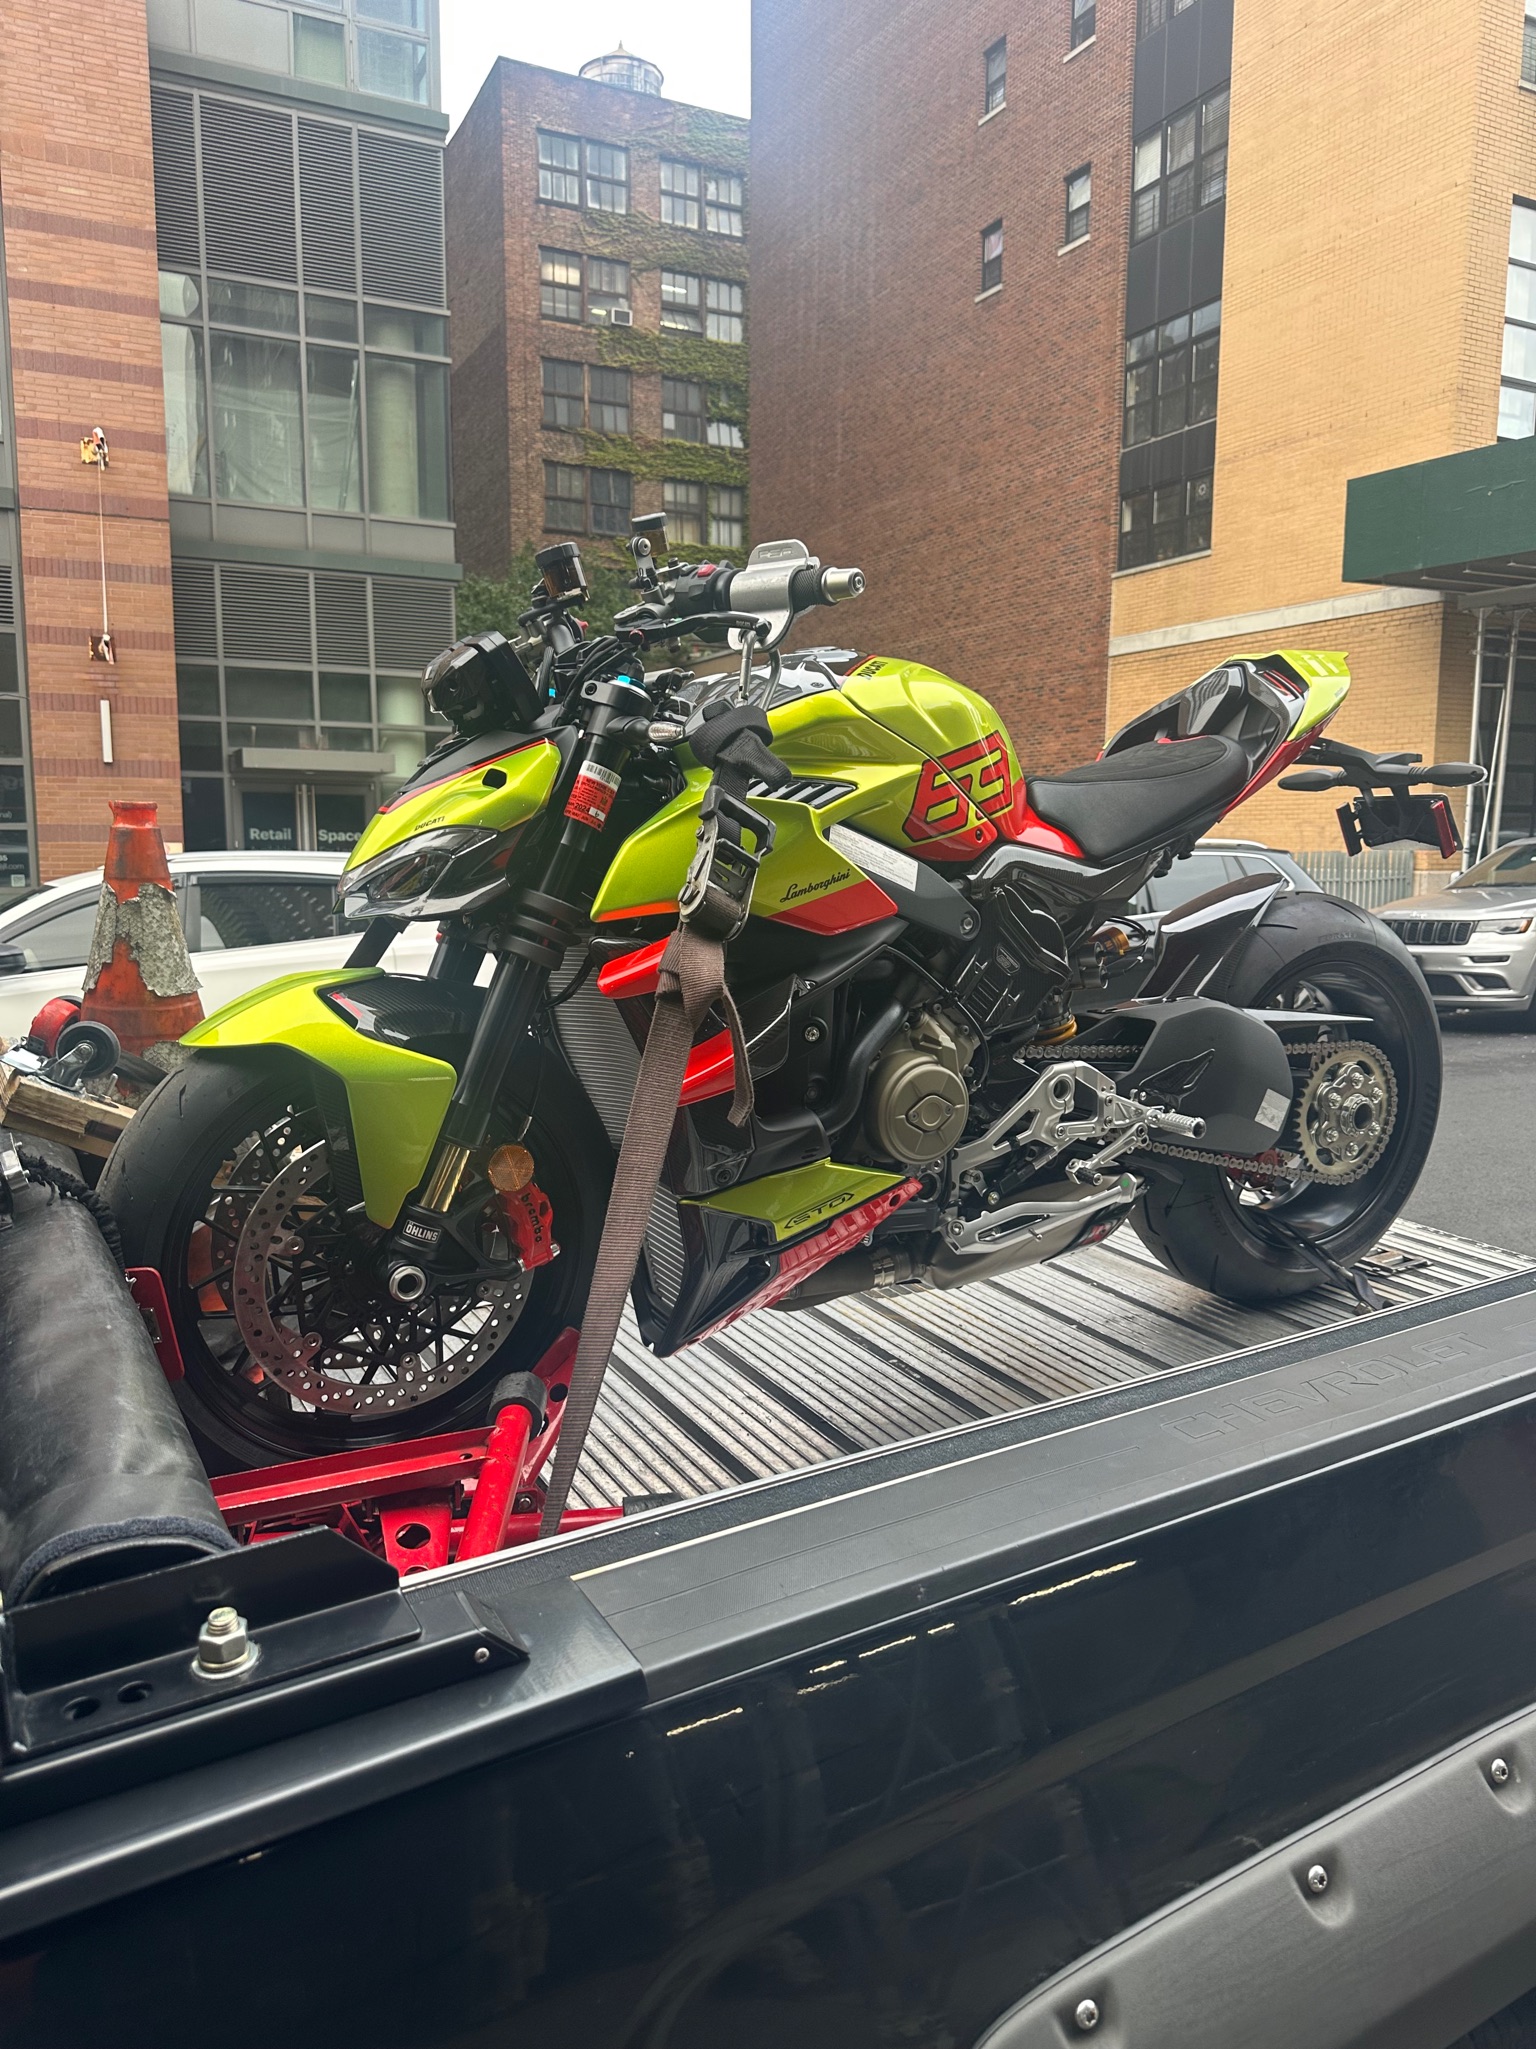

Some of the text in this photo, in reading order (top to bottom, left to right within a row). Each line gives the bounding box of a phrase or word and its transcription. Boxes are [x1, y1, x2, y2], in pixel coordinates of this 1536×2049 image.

[574, 802, 591, 814] 2024
[249, 827, 292, 841] Retail
[780, 868, 850, 903] Lamborghini
[405, 1220, 440, 1242] ÖHLINS
[520, 1192, 543, 1243] brembo
[1159, 1331, 1488, 1443] CHEVROLET
